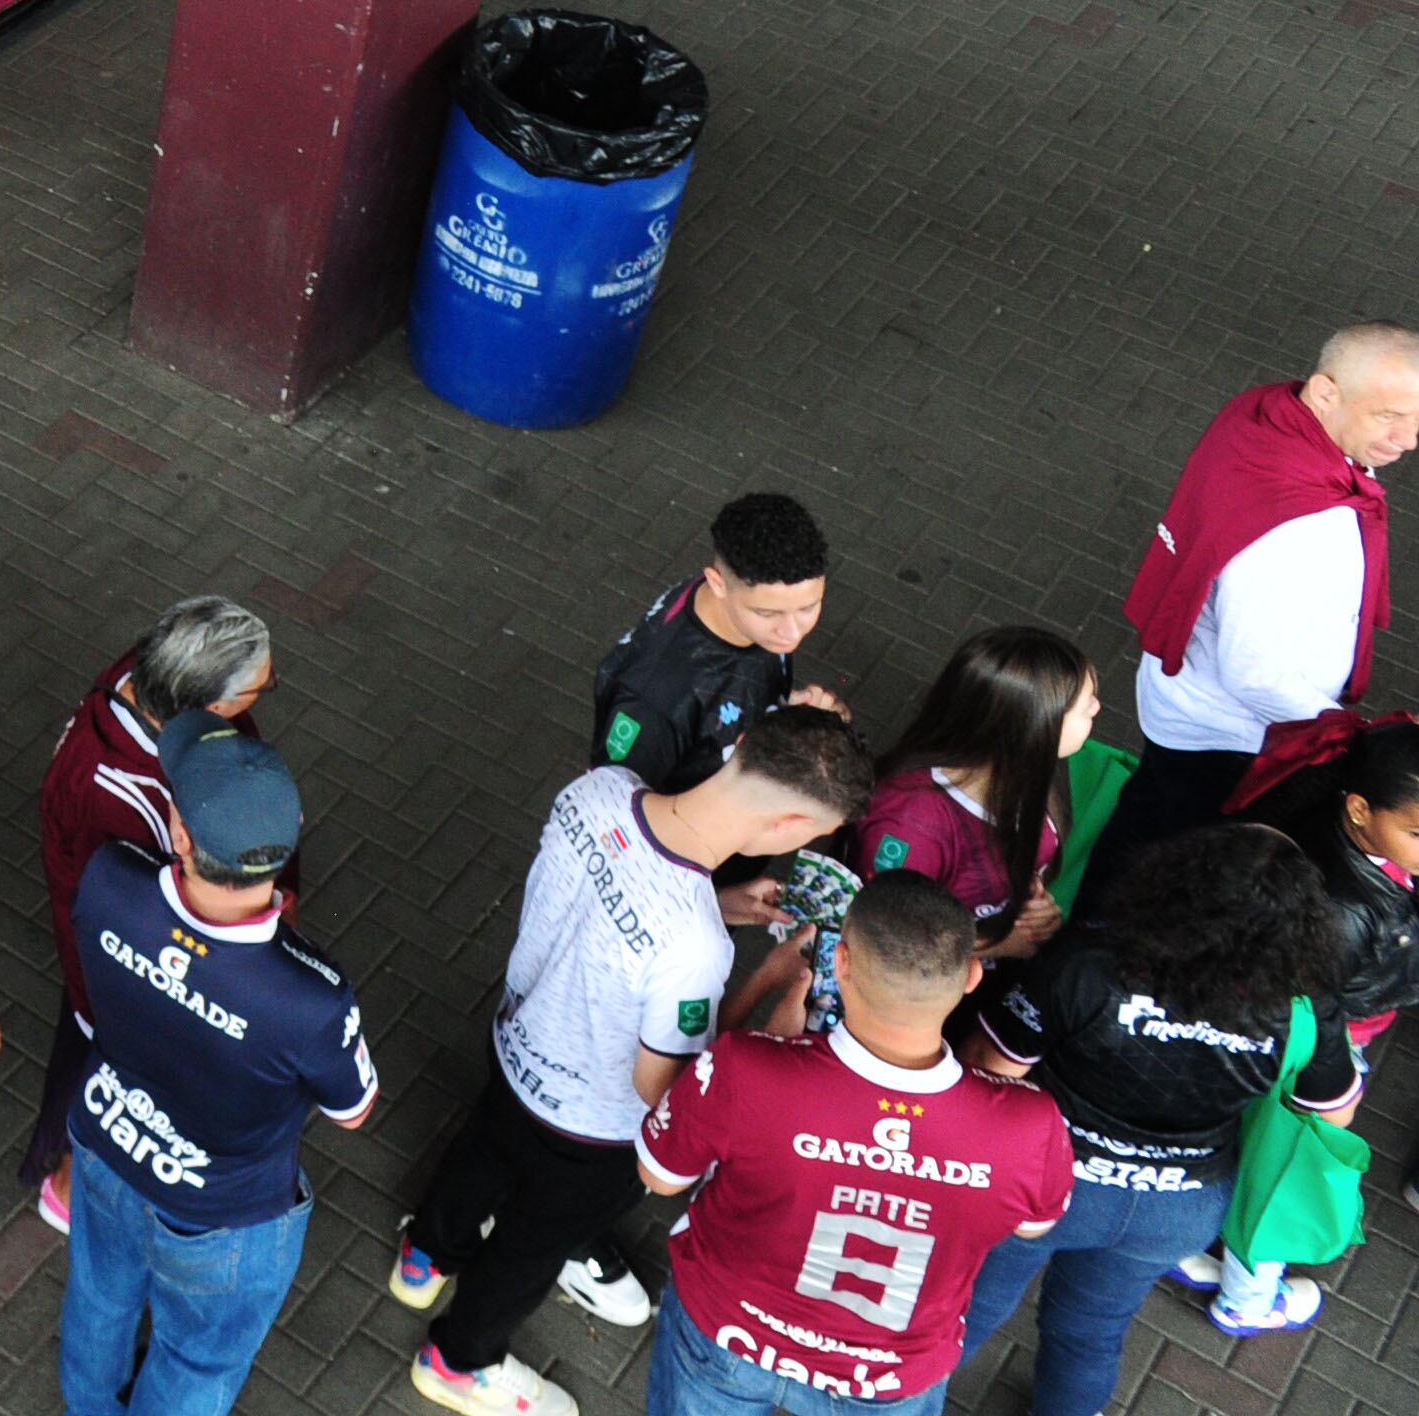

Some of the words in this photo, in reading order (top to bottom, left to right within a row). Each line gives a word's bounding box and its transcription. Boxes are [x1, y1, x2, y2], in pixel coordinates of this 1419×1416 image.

[557, 804, 656, 956] GATORADE
[99, 928, 249, 1042] GATORADE
[158, 945, 192, 983] G
[82, 1071, 193, 1189] Claro
[792, 1132, 993, 1190] GATORADE
[872, 1118, 912, 1151] G
[831, 1184, 933, 1231] PATE
[794, 1210, 936, 1333] 8
